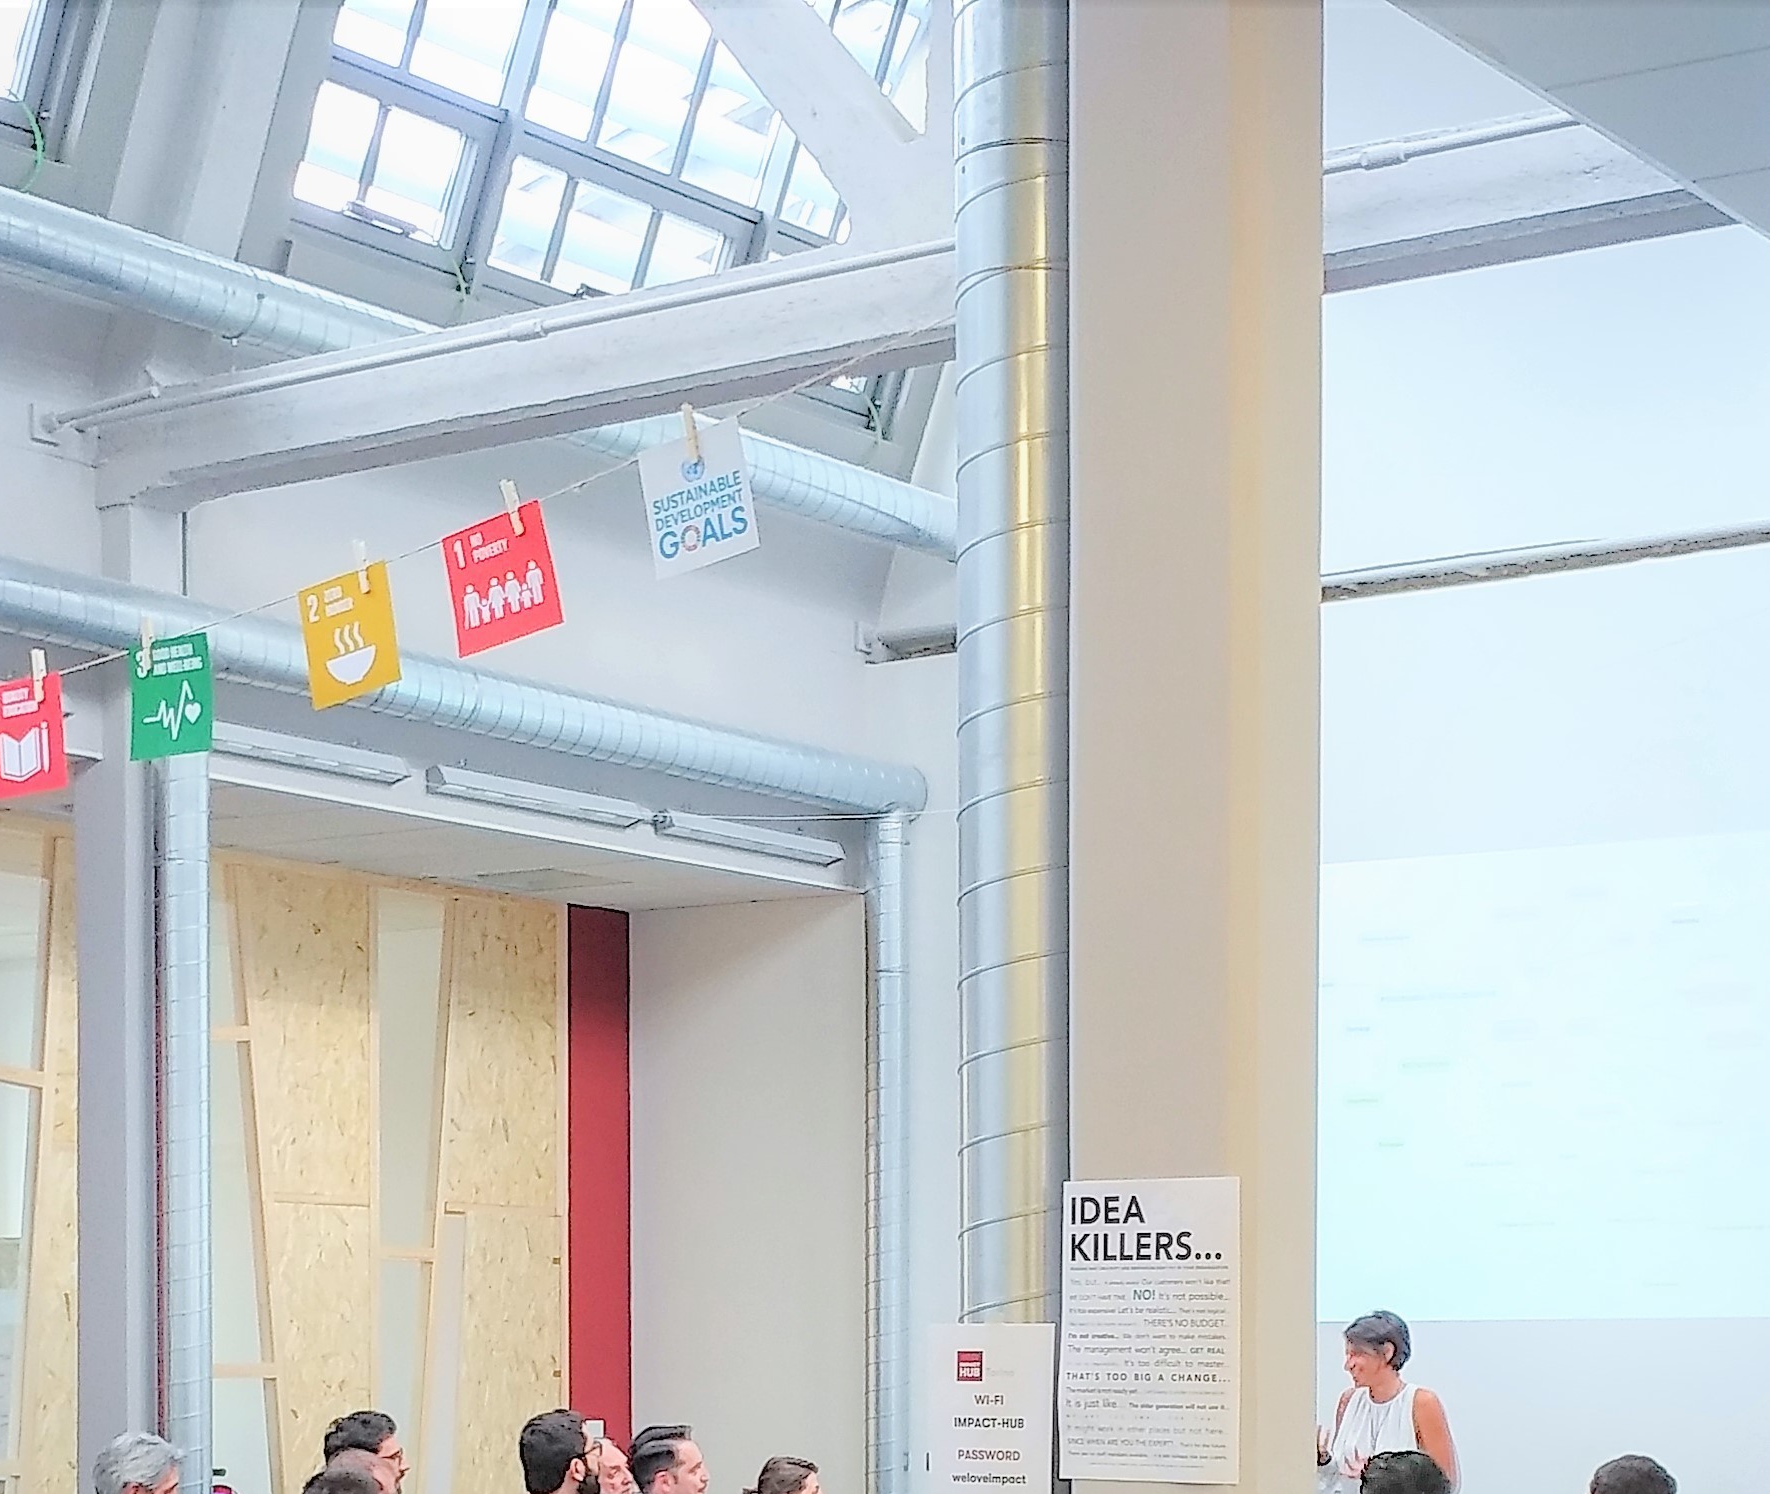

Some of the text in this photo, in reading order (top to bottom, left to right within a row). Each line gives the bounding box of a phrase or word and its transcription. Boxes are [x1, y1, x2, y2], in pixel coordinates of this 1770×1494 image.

[653, 470, 742, 515] SUSTAINABLE
[656, 488, 742, 531] DEVELOPMENT
[660, 506, 748, 559] GOALS
[453, 540, 466, 569] 1
[307, 594, 320, 623] 2
[1070, 1196, 1146, 1225] IDEA
[1070, 1232, 1222, 1262] KILLERS...
[1133, 1289, 1156, 1301] NO!
[1175, 1319, 1189, 1328] NO
[959, 1367, 981, 1378] HUB
[1066, 1372, 1100, 1381] THAT'S
[1107, 1372, 1128, 1381] TOO
[1134, 1373, 1152, 1382] BIG
[1157, 1373, 1165, 1382] A
[974, 1395, 1004, 1405] WI-FI
[954, 1417, 1025, 1428] IMPACT-HUB
[958, 1449, 1021, 1461] PASSWORD
[952, 1473, 1027, 1486] weloveimpact
